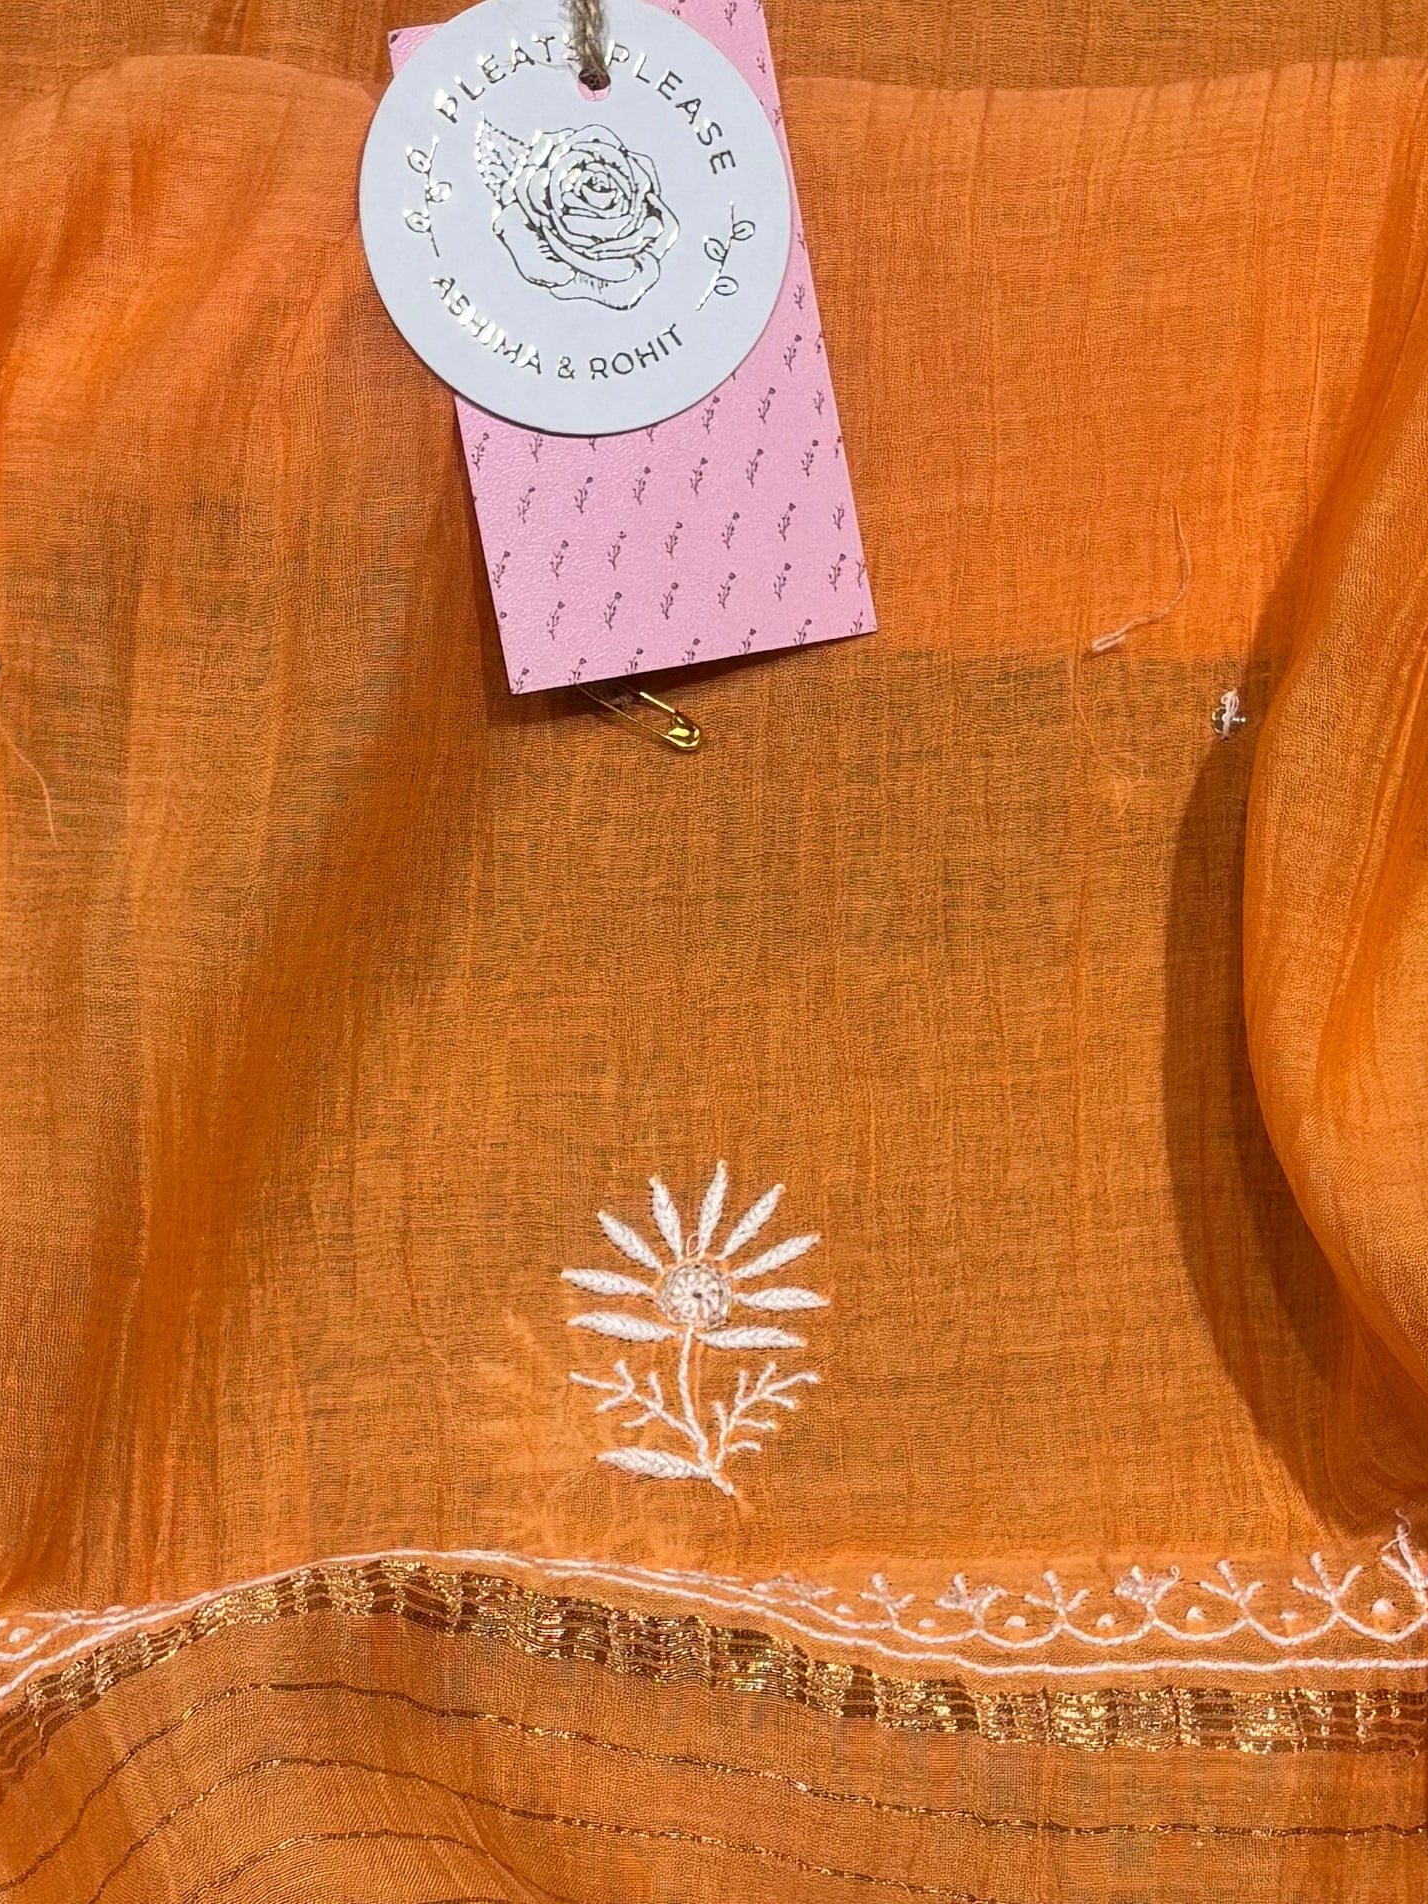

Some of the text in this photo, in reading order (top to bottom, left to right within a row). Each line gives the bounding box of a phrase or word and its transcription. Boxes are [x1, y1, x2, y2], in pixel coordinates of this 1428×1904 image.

[604, 39, 736, 175] PLEASE
[429, 276, 684, 381] ASHIMA & ROHIT
